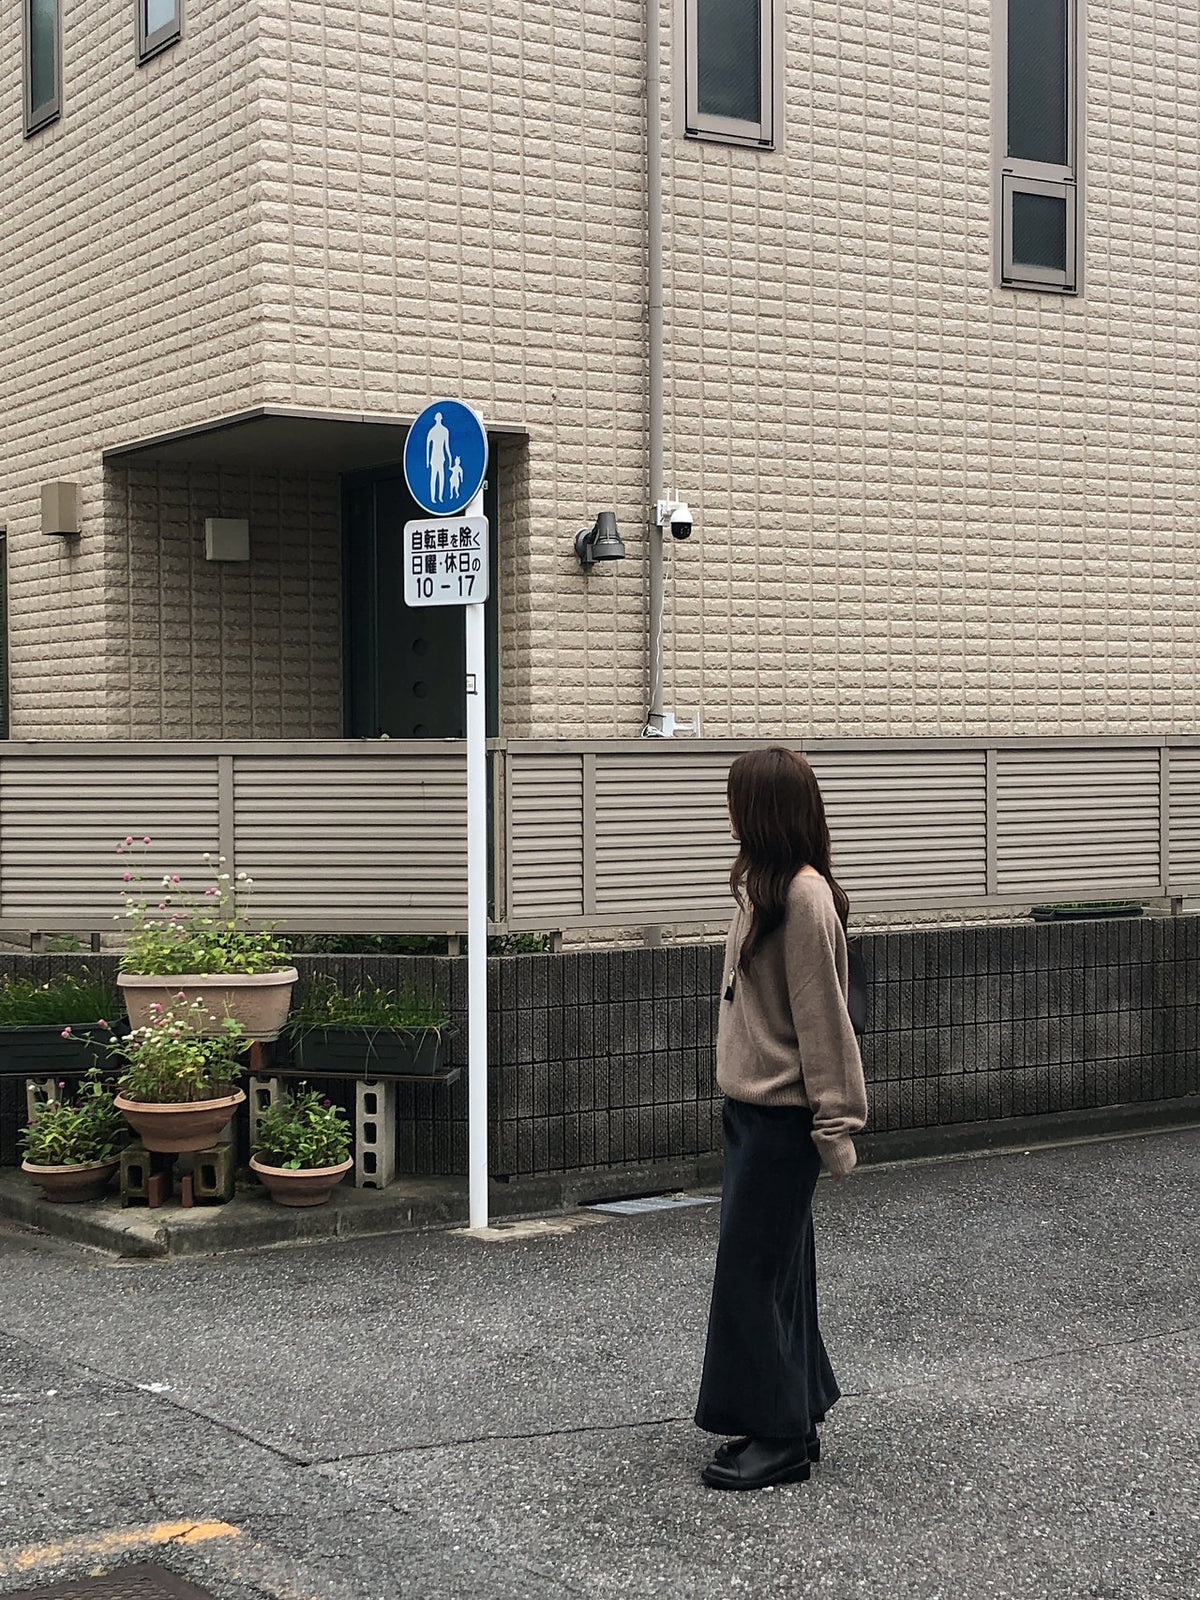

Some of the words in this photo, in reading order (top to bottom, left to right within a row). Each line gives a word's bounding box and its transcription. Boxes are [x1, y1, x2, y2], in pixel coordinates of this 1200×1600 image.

[412, 526, 480, 550] 自転車を除く
[412, 552, 480, 575] 日曜・休日の
